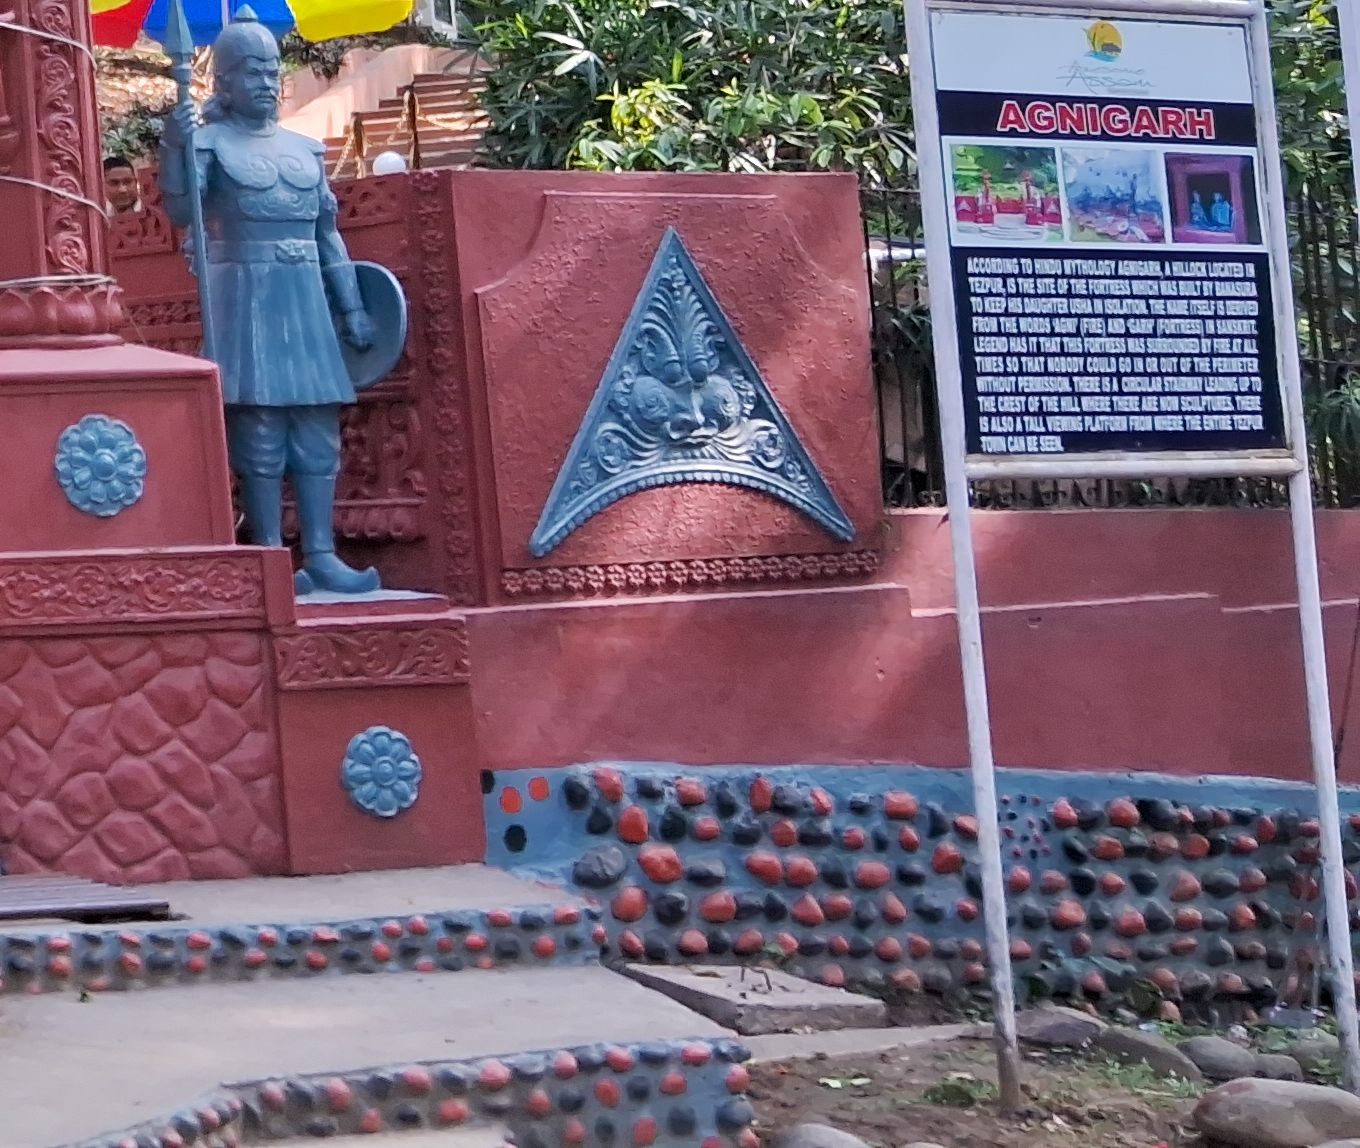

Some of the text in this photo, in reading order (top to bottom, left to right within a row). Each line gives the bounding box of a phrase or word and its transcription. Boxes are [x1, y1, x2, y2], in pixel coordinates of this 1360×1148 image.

[996, 100, 1216, 140] AGNIGARH
[967, 257, 1019, 274] ACCORDING
[1020, 258, 1033, 274] TO
[1034, 258, 1062, 275] HINDU
[1063, 259, 1116, 275] MYTHOLOGY
[1165, 261, 1172, 277] A
[1172, 261, 1207, 277] HILLOCK
[1208, 262, 1244, 277] LOCATED
[1245, 262, 1256, 278] IN
[968, 277, 1006, 297] TEZPUR,
[1007, 278, 1017, 294] IS
[1017, 278, 1036, 294] THE
[1036, 278, 1057, 294] SITE
[1057, 278, 1069, 295] OF
[1069, 278, 1088, 295] THE
[1088, 279, 1131, 295] FORTRESS
[1131, 279, 1160, 296] WHICH
[1160, 280, 1178, 296] WAS
[1178, 280, 1201, 296] BUILT
[1202, 280, 1214, 296] BY
[970, 297, 983, 313] TO
[984, 297, 1006, 313] KEEP
[1008, 298, 1023, 313] HIS
[1024, 298, 1068, 313] DAUGHTER
[1069, 298, 1092, 314] USHA
[1093, 299, 1103, 314] IN
[1148, 299, 1166, 315] THE
[1167, 300, 1188, 315] NAME
[1190, 300, 1215, 315] ITSELF
[1216, 300, 1224, 316] IS
[1225, 300, 1259, 316] DERIVED
[972, 317, 998, 333] FROM
[999, 317, 1018, 333] THE
[1018, 317, 1051, 333] WORDS
[1107, 318, 1125, 334] AND
[1205, 319, 1215, 334] IN
[974, 337, 1259, 354] LEGEND HAS IT THAT THIS FORTRESS WAS SURROUNDED BY FIRE AT ALL
[975, 357, 1259, 372] TIMES SO THAT NOBODY COULD GO IN OR OUT OF THE PERIMETER
[976, 376, 1016, 392] WITHOUT
[1072, 376, 1101, 392] THERE
[1101, 376, 1110, 392] IS
[1112, 376, 1119, 392] A
[1122, 376, 1163, 392] CIRCULAR
[1163, 376, 1203, 392] STAIRWAY
[1203, 376, 1238, 392] LEADING
[1239, 376, 1250, 392] UP
[1250, 376, 1262, 392] TO
[978, 396, 997, 412] THE
[997, 396, 1026, 412] CREST
[1027, 396, 1040, 412] OF
[1041, 396, 1060, 412] THE
[1080, 396, 1112, 412] WHERE
[1112, 396, 1140, 411] THERE
[1142, 396, 1159, 411] ARE
[1160, 396, 1179, 411] NOW
[1235, 396, 1262, 411] THERE
[979, 415, 1264, 432] IS ALSO A TALL VIEWING PLATFORM FROM WHERE THE ENTIRE TEZPUR
[980, 436, 1006, 452] TOWN
[1007, 436, 1025, 452] CAN
[1026, 436, 1038, 452] BE
